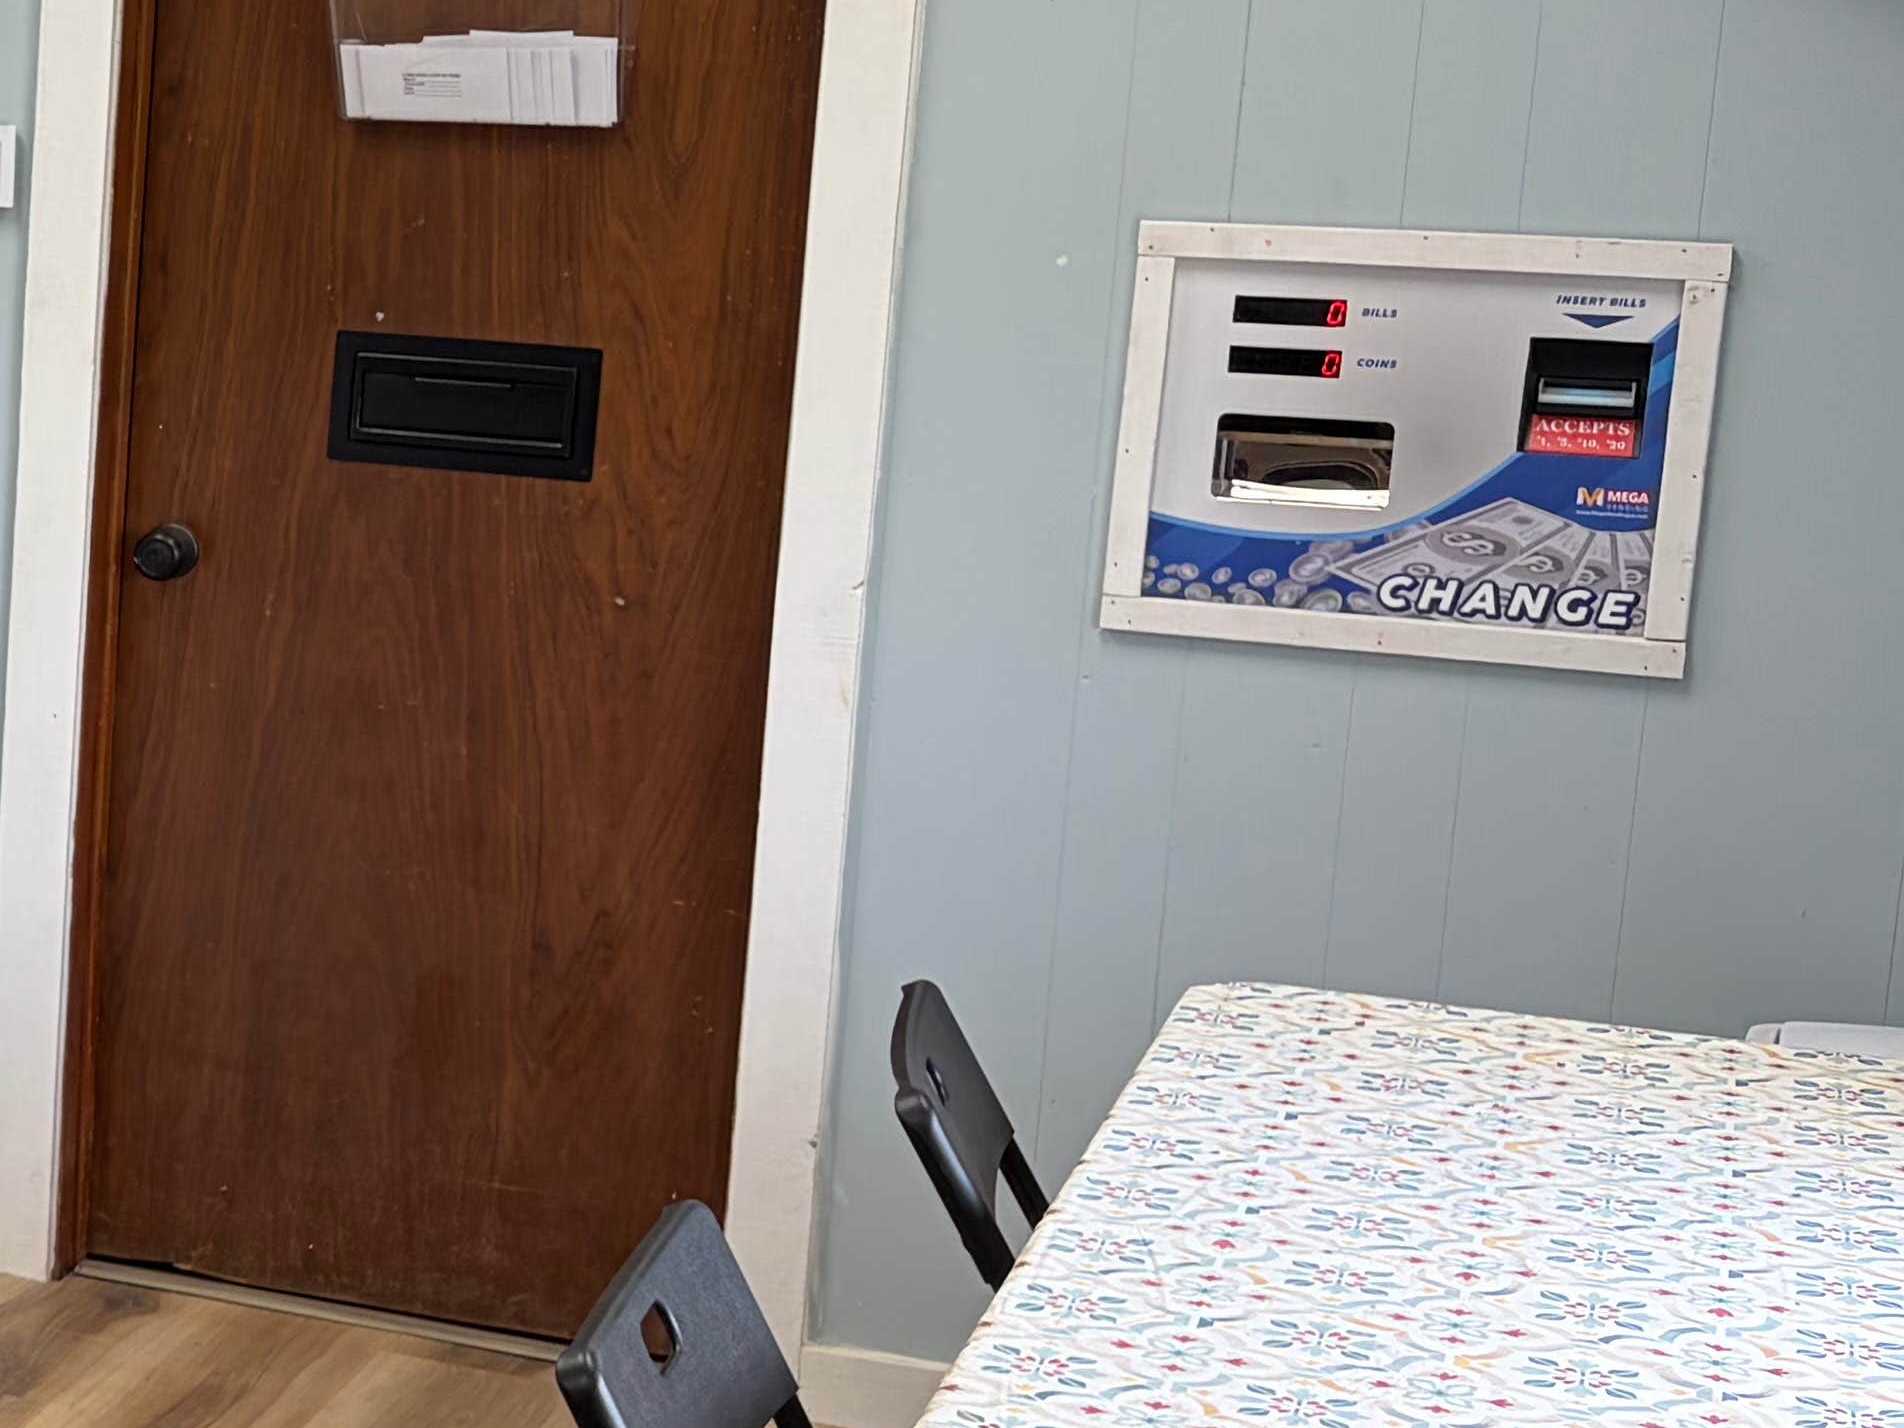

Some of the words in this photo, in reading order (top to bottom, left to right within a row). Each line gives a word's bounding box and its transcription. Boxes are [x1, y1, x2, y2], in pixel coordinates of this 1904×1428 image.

[1555, 294, 1607, 307] INSERT
[1609, 297, 1647, 309] BILLS
[1326, 301, 1346, 326] 0
[1361, 307, 1399, 319] BILLS
[1321, 353, 1341, 376] 0
[1356, 358, 1398, 370] COINS
[1535, 418, 1631, 436] ACCEPTS
[1607, 491, 1649, 505] MEGA
[1377, 571, 1640, 630] CHANGE
